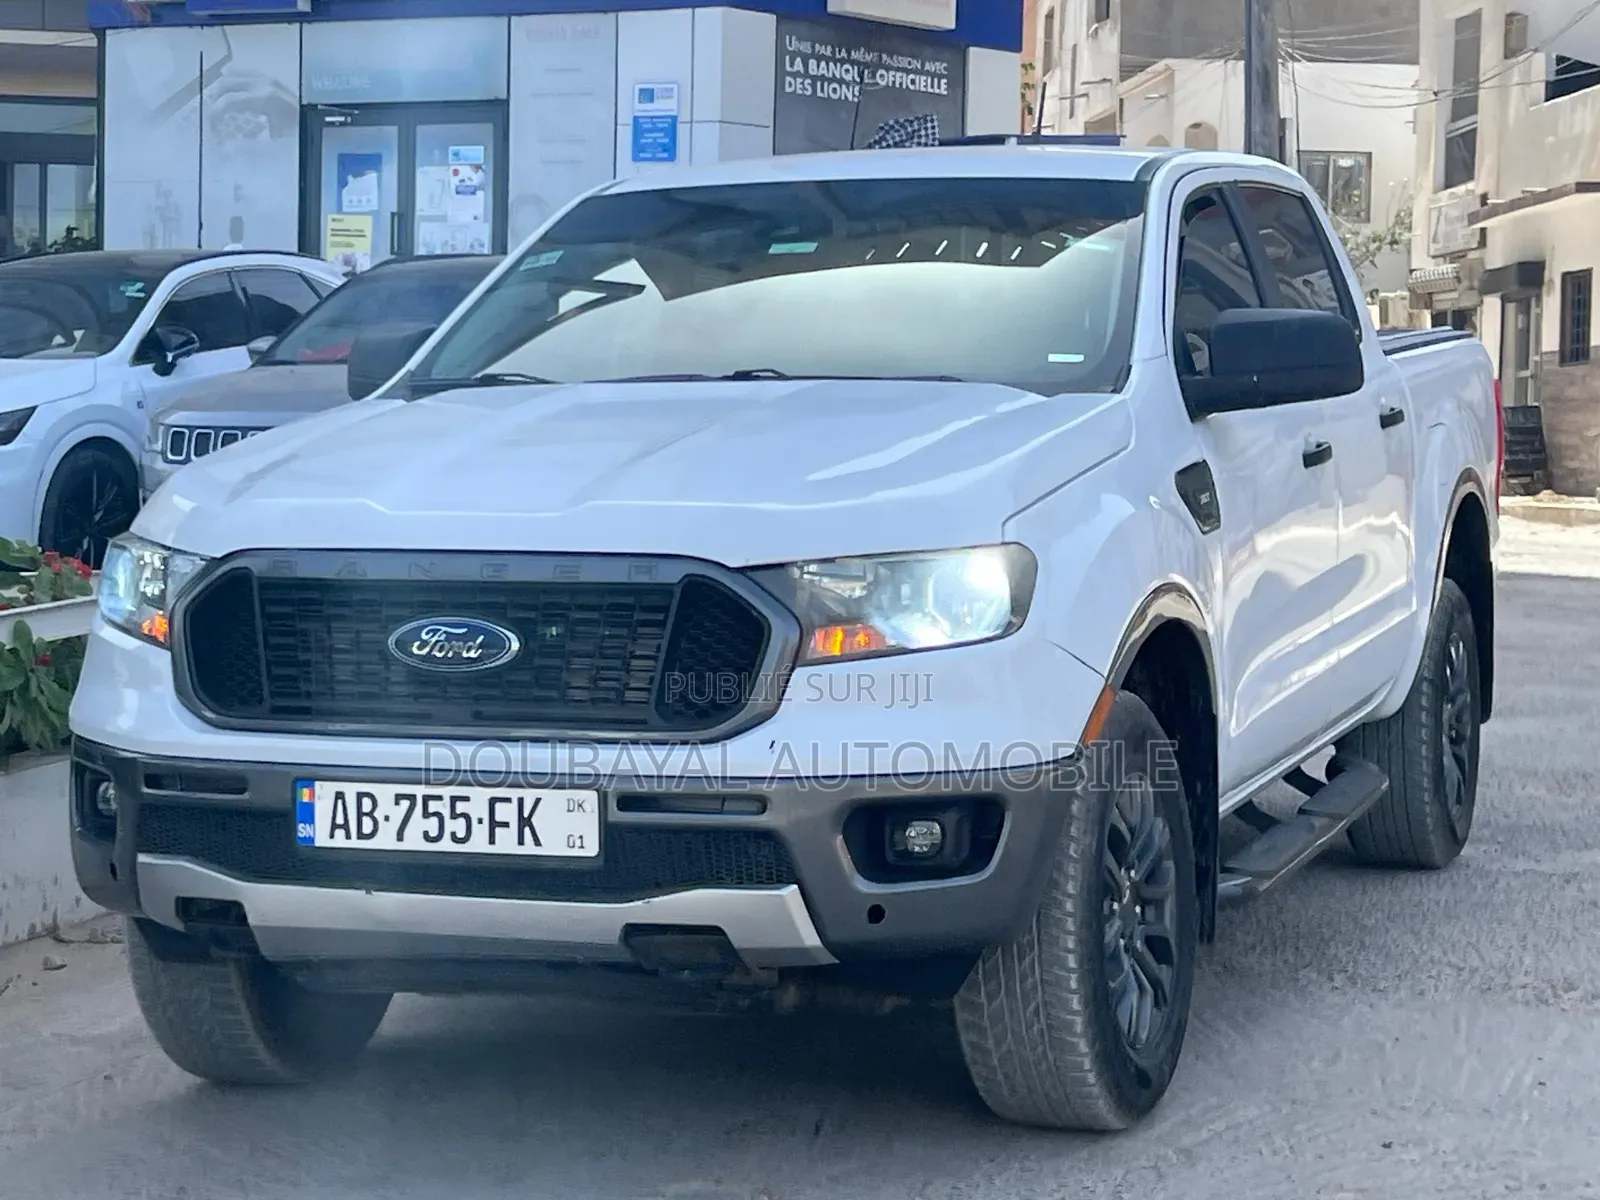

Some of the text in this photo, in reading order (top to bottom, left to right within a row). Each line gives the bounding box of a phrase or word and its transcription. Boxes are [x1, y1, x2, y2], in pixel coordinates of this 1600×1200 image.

[815, 43, 832, 57] PAR
[835, 47, 848, 60] LA
[881, 52, 922, 71] PASSION
[924, 60, 949, 75] AVEC
[784, 76, 813, 97] DES
[785, 55, 805, 74] LA
[876, 68, 948, 96] OFFICIELLE
[270, 555, 659, 581] RANGER
[411, 625, 487, 659] Ford
[566, 798, 587, 813] DK
[298, 823, 314, 838] SN
